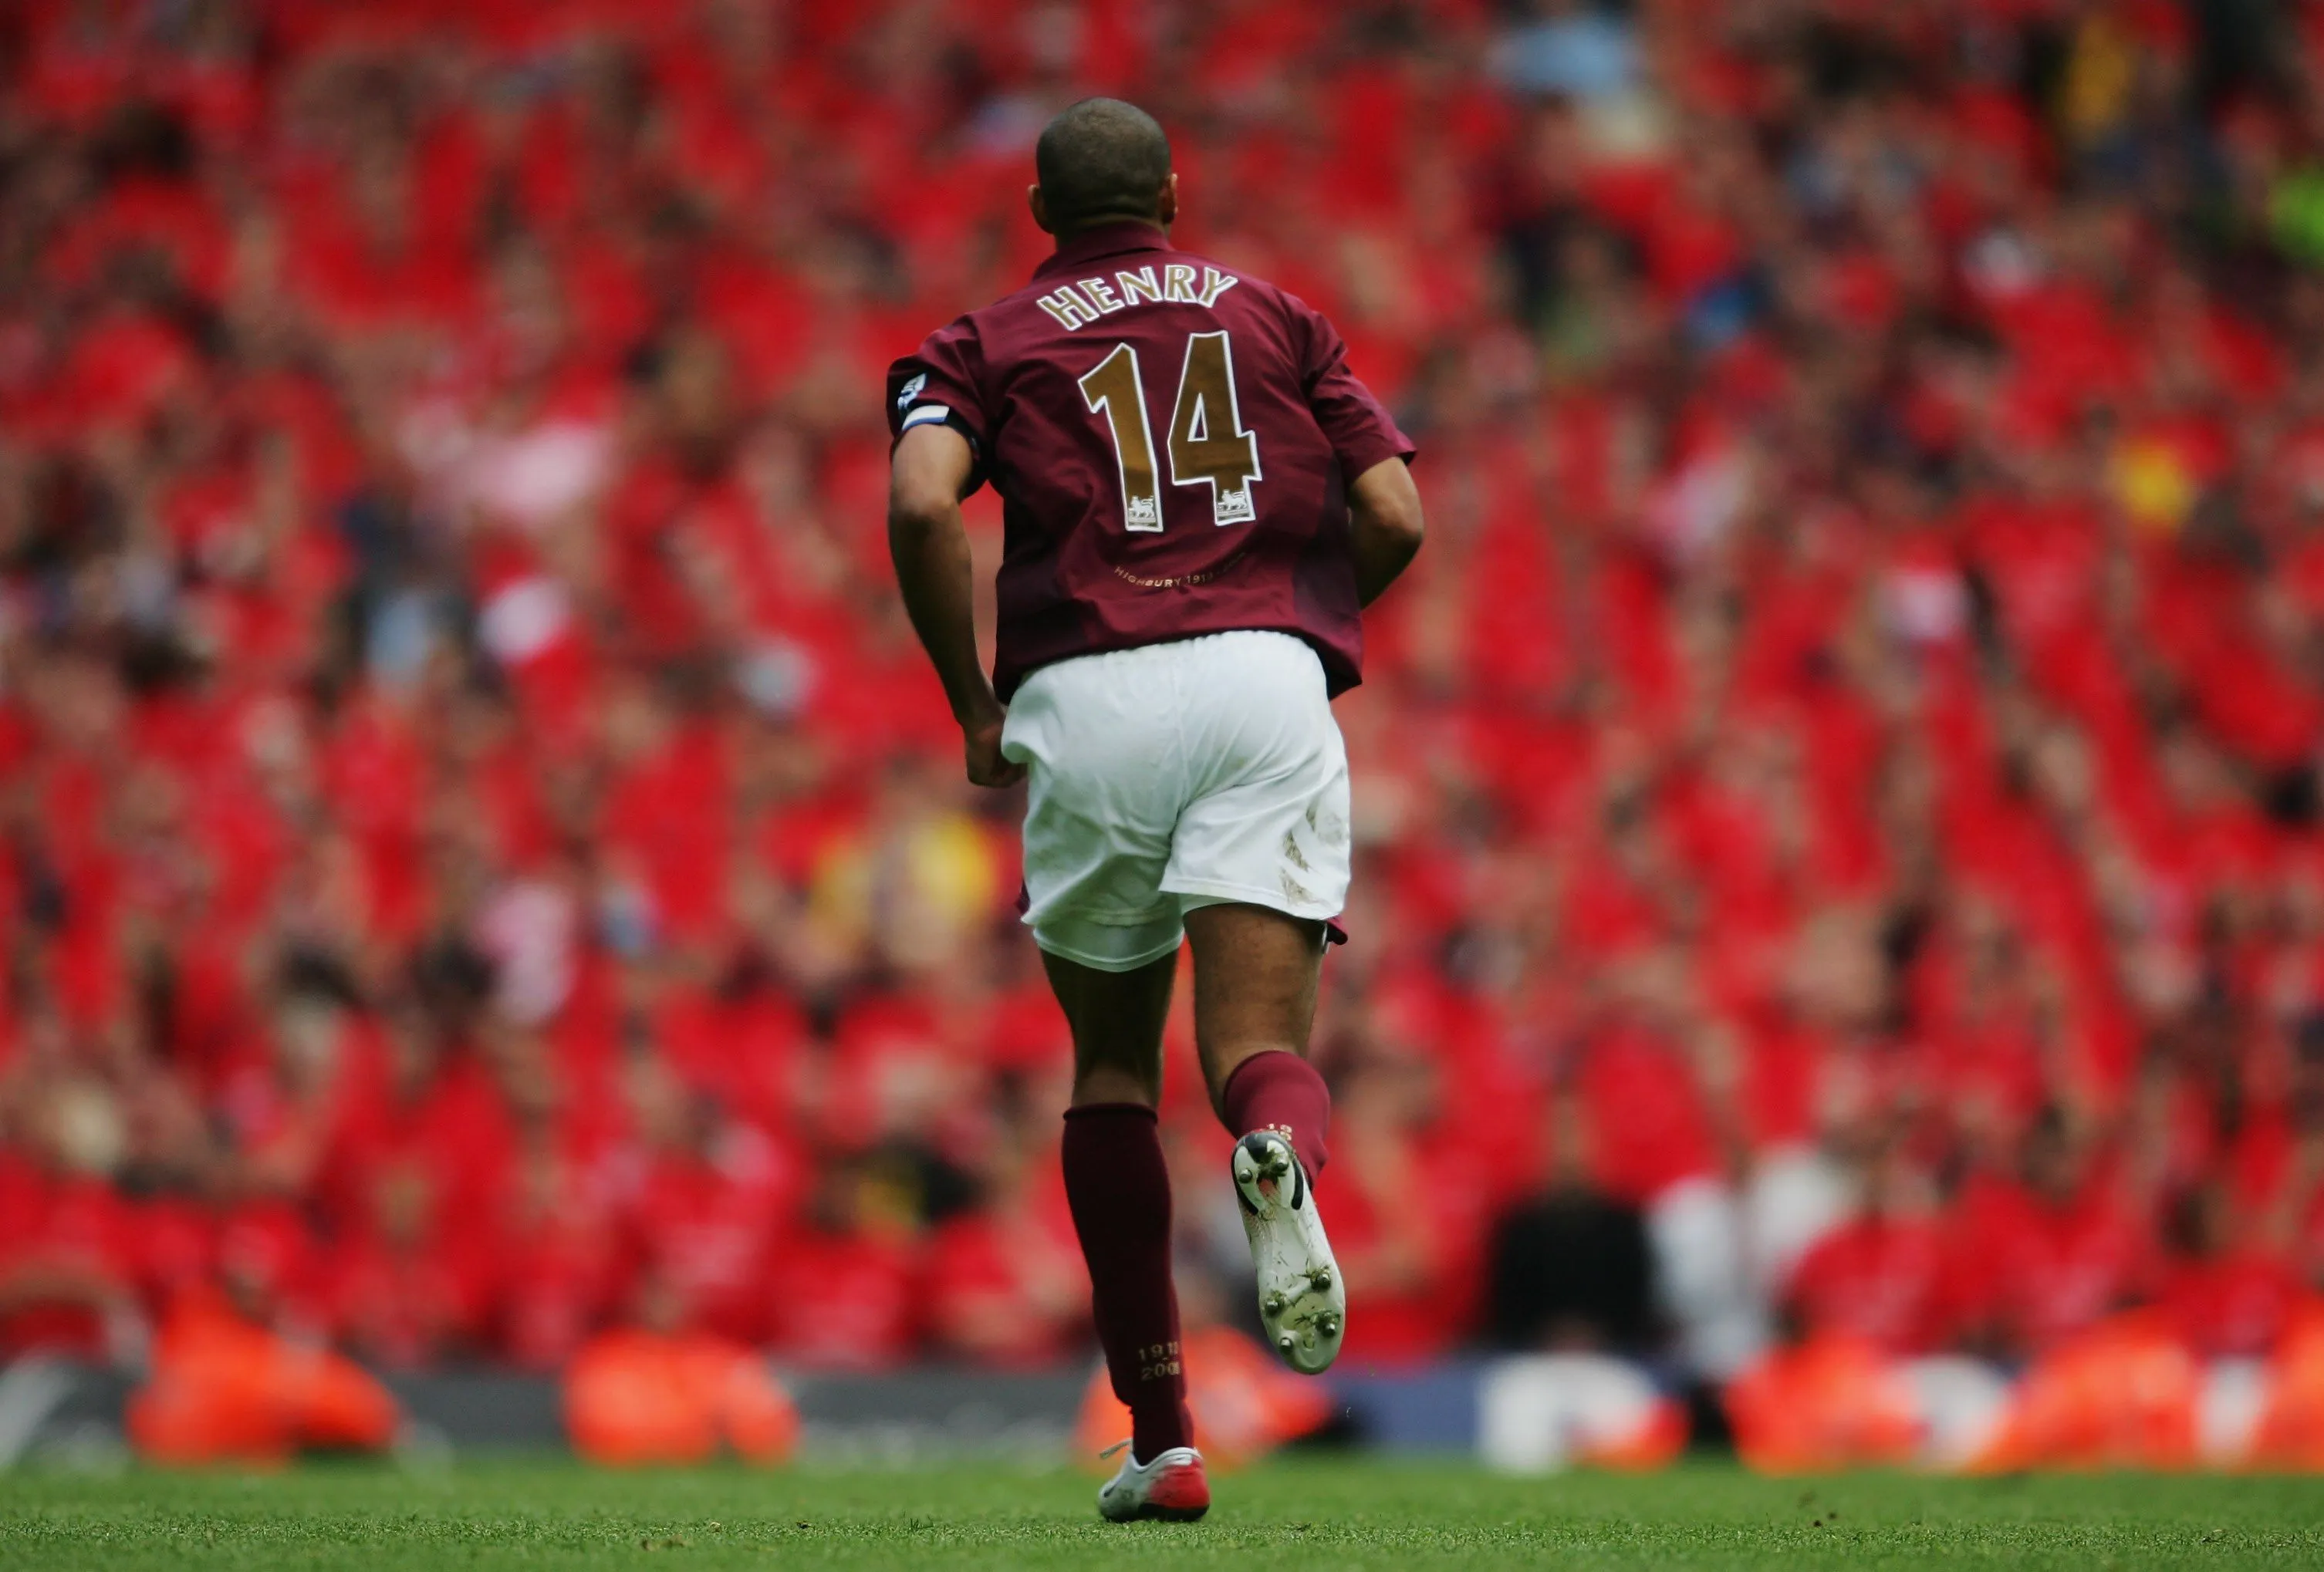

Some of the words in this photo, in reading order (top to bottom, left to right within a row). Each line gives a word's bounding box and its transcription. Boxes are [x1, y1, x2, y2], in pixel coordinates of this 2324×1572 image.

[1036, 264, 1238, 331] HENRY
[1077, 329, 1262, 532] 14
[1114, 566, 1182, 587] HIGHBURY
